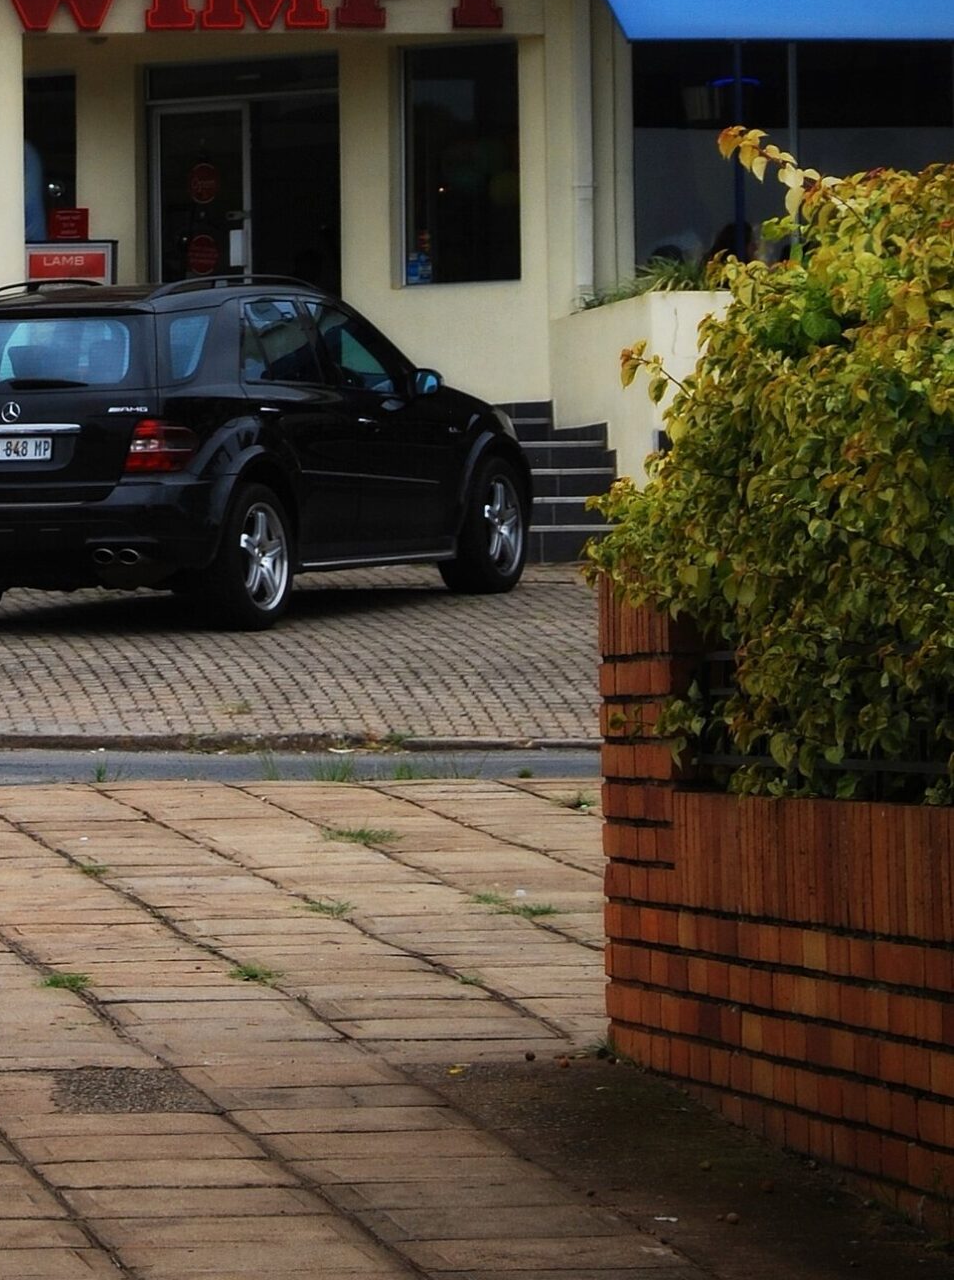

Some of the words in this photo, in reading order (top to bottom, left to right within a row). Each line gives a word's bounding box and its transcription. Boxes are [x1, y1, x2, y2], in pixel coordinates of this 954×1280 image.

[43, 255, 85, 267] LAMB
[5, 440, 29, 457] 848
[34, 440, 51, 457] MP
